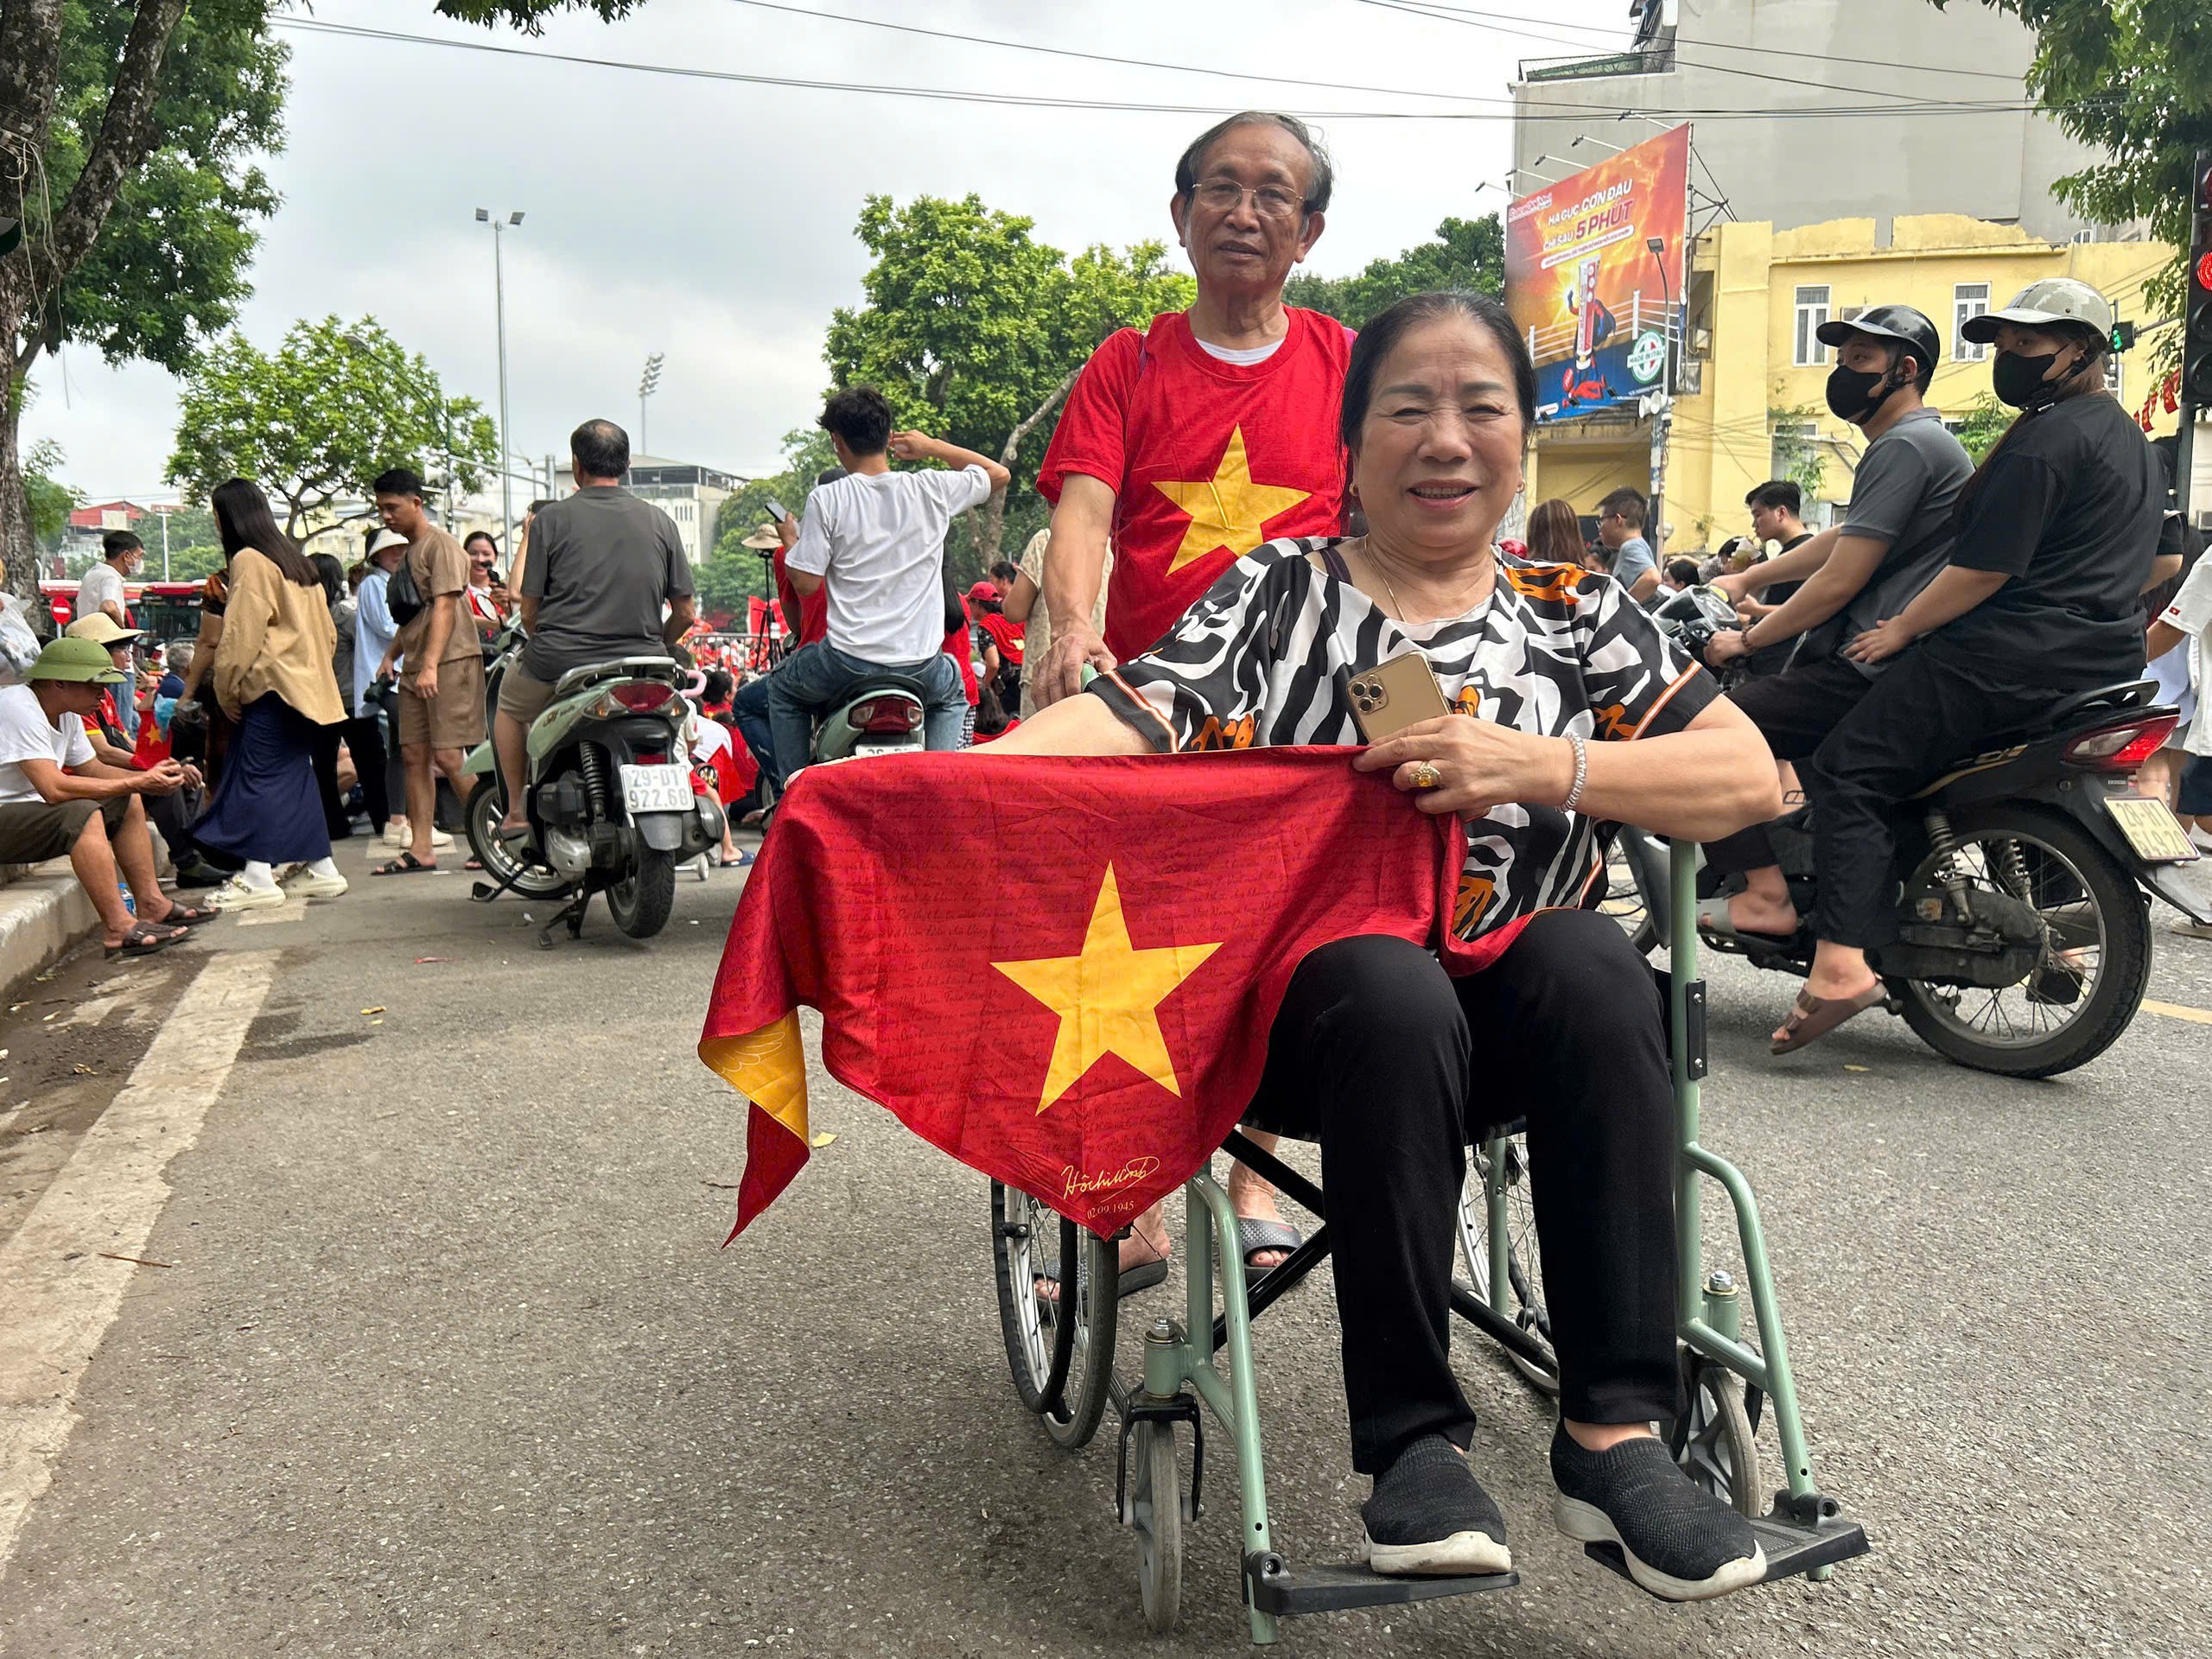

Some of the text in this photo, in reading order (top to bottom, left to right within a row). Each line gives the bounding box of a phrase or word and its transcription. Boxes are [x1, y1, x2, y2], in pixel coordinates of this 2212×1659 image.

[1581, 189, 1607, 211] CƠN
[1575, 220, 1586, 240] 5
[1587, 198, 1634, 235] PHÚT
[628, 787, 689, 809] 922.68
